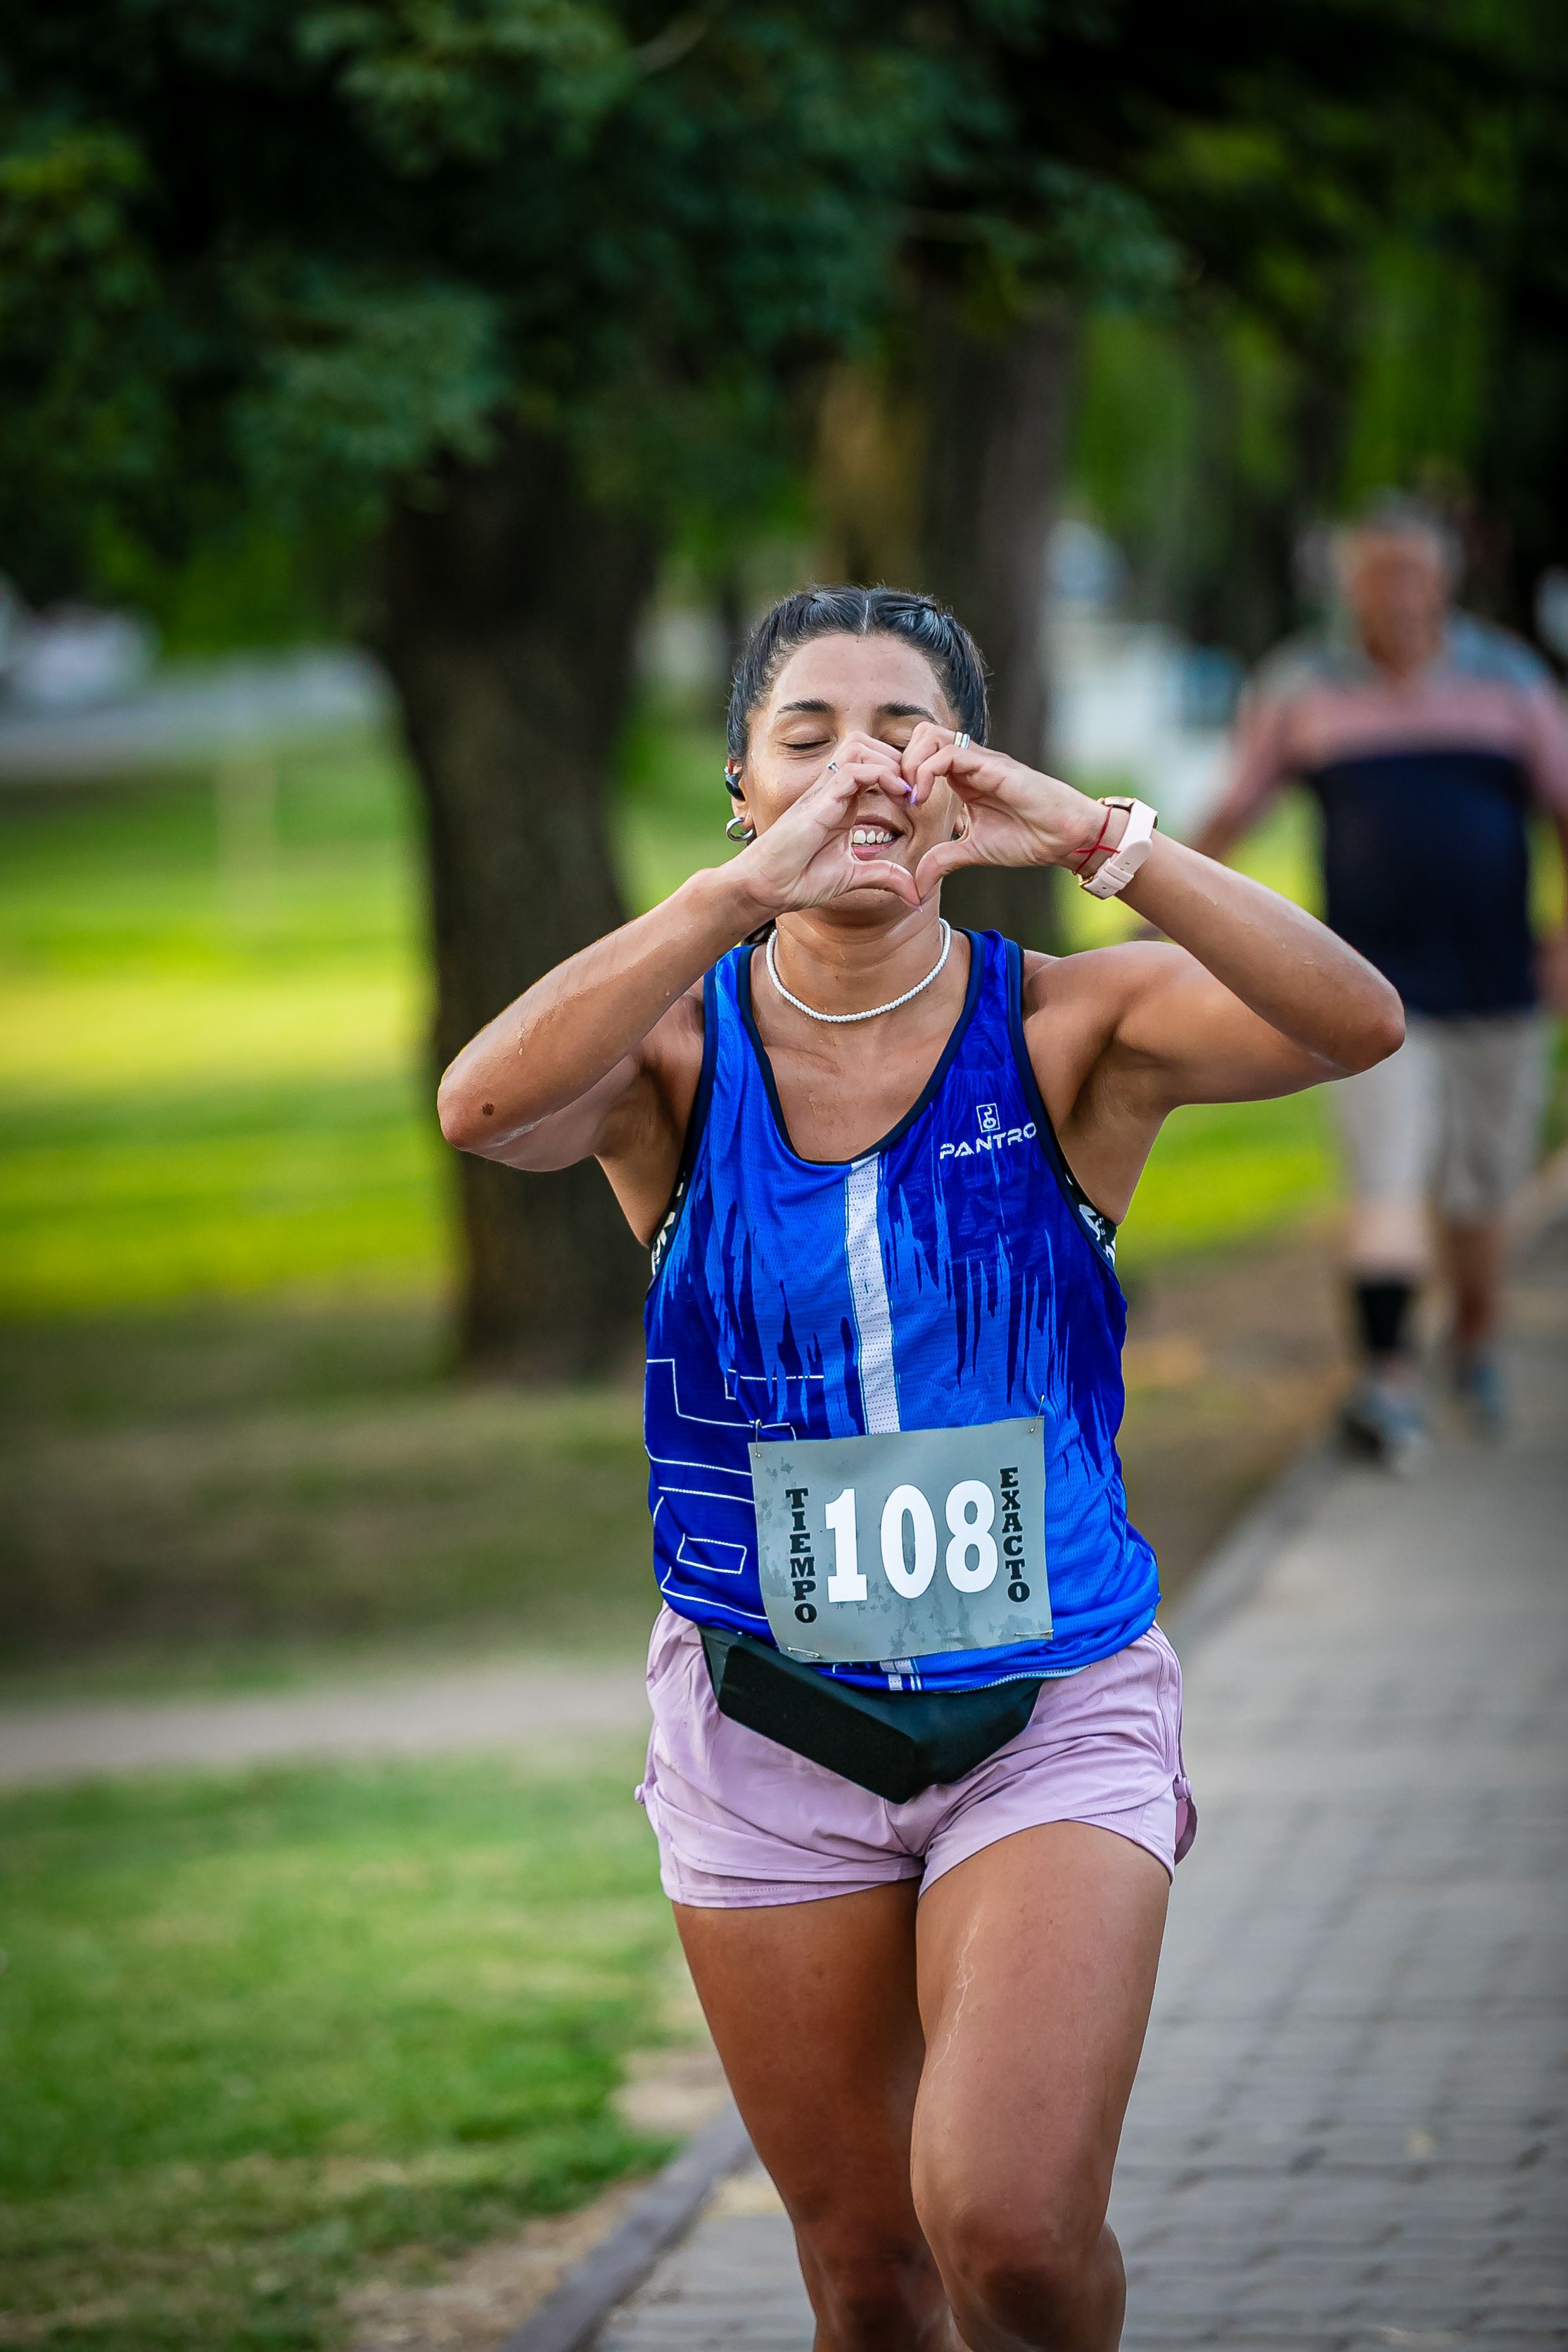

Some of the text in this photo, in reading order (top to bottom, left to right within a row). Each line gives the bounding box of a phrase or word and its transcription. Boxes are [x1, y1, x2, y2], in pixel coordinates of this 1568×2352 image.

[939, 1122, 1037, 1160] PANTRO
[785, 1487, 817, 1624] TIEMPO
[824, 1479, 999, 1603] 108
[1000, 1466, 1031, 1603] EXACTO
